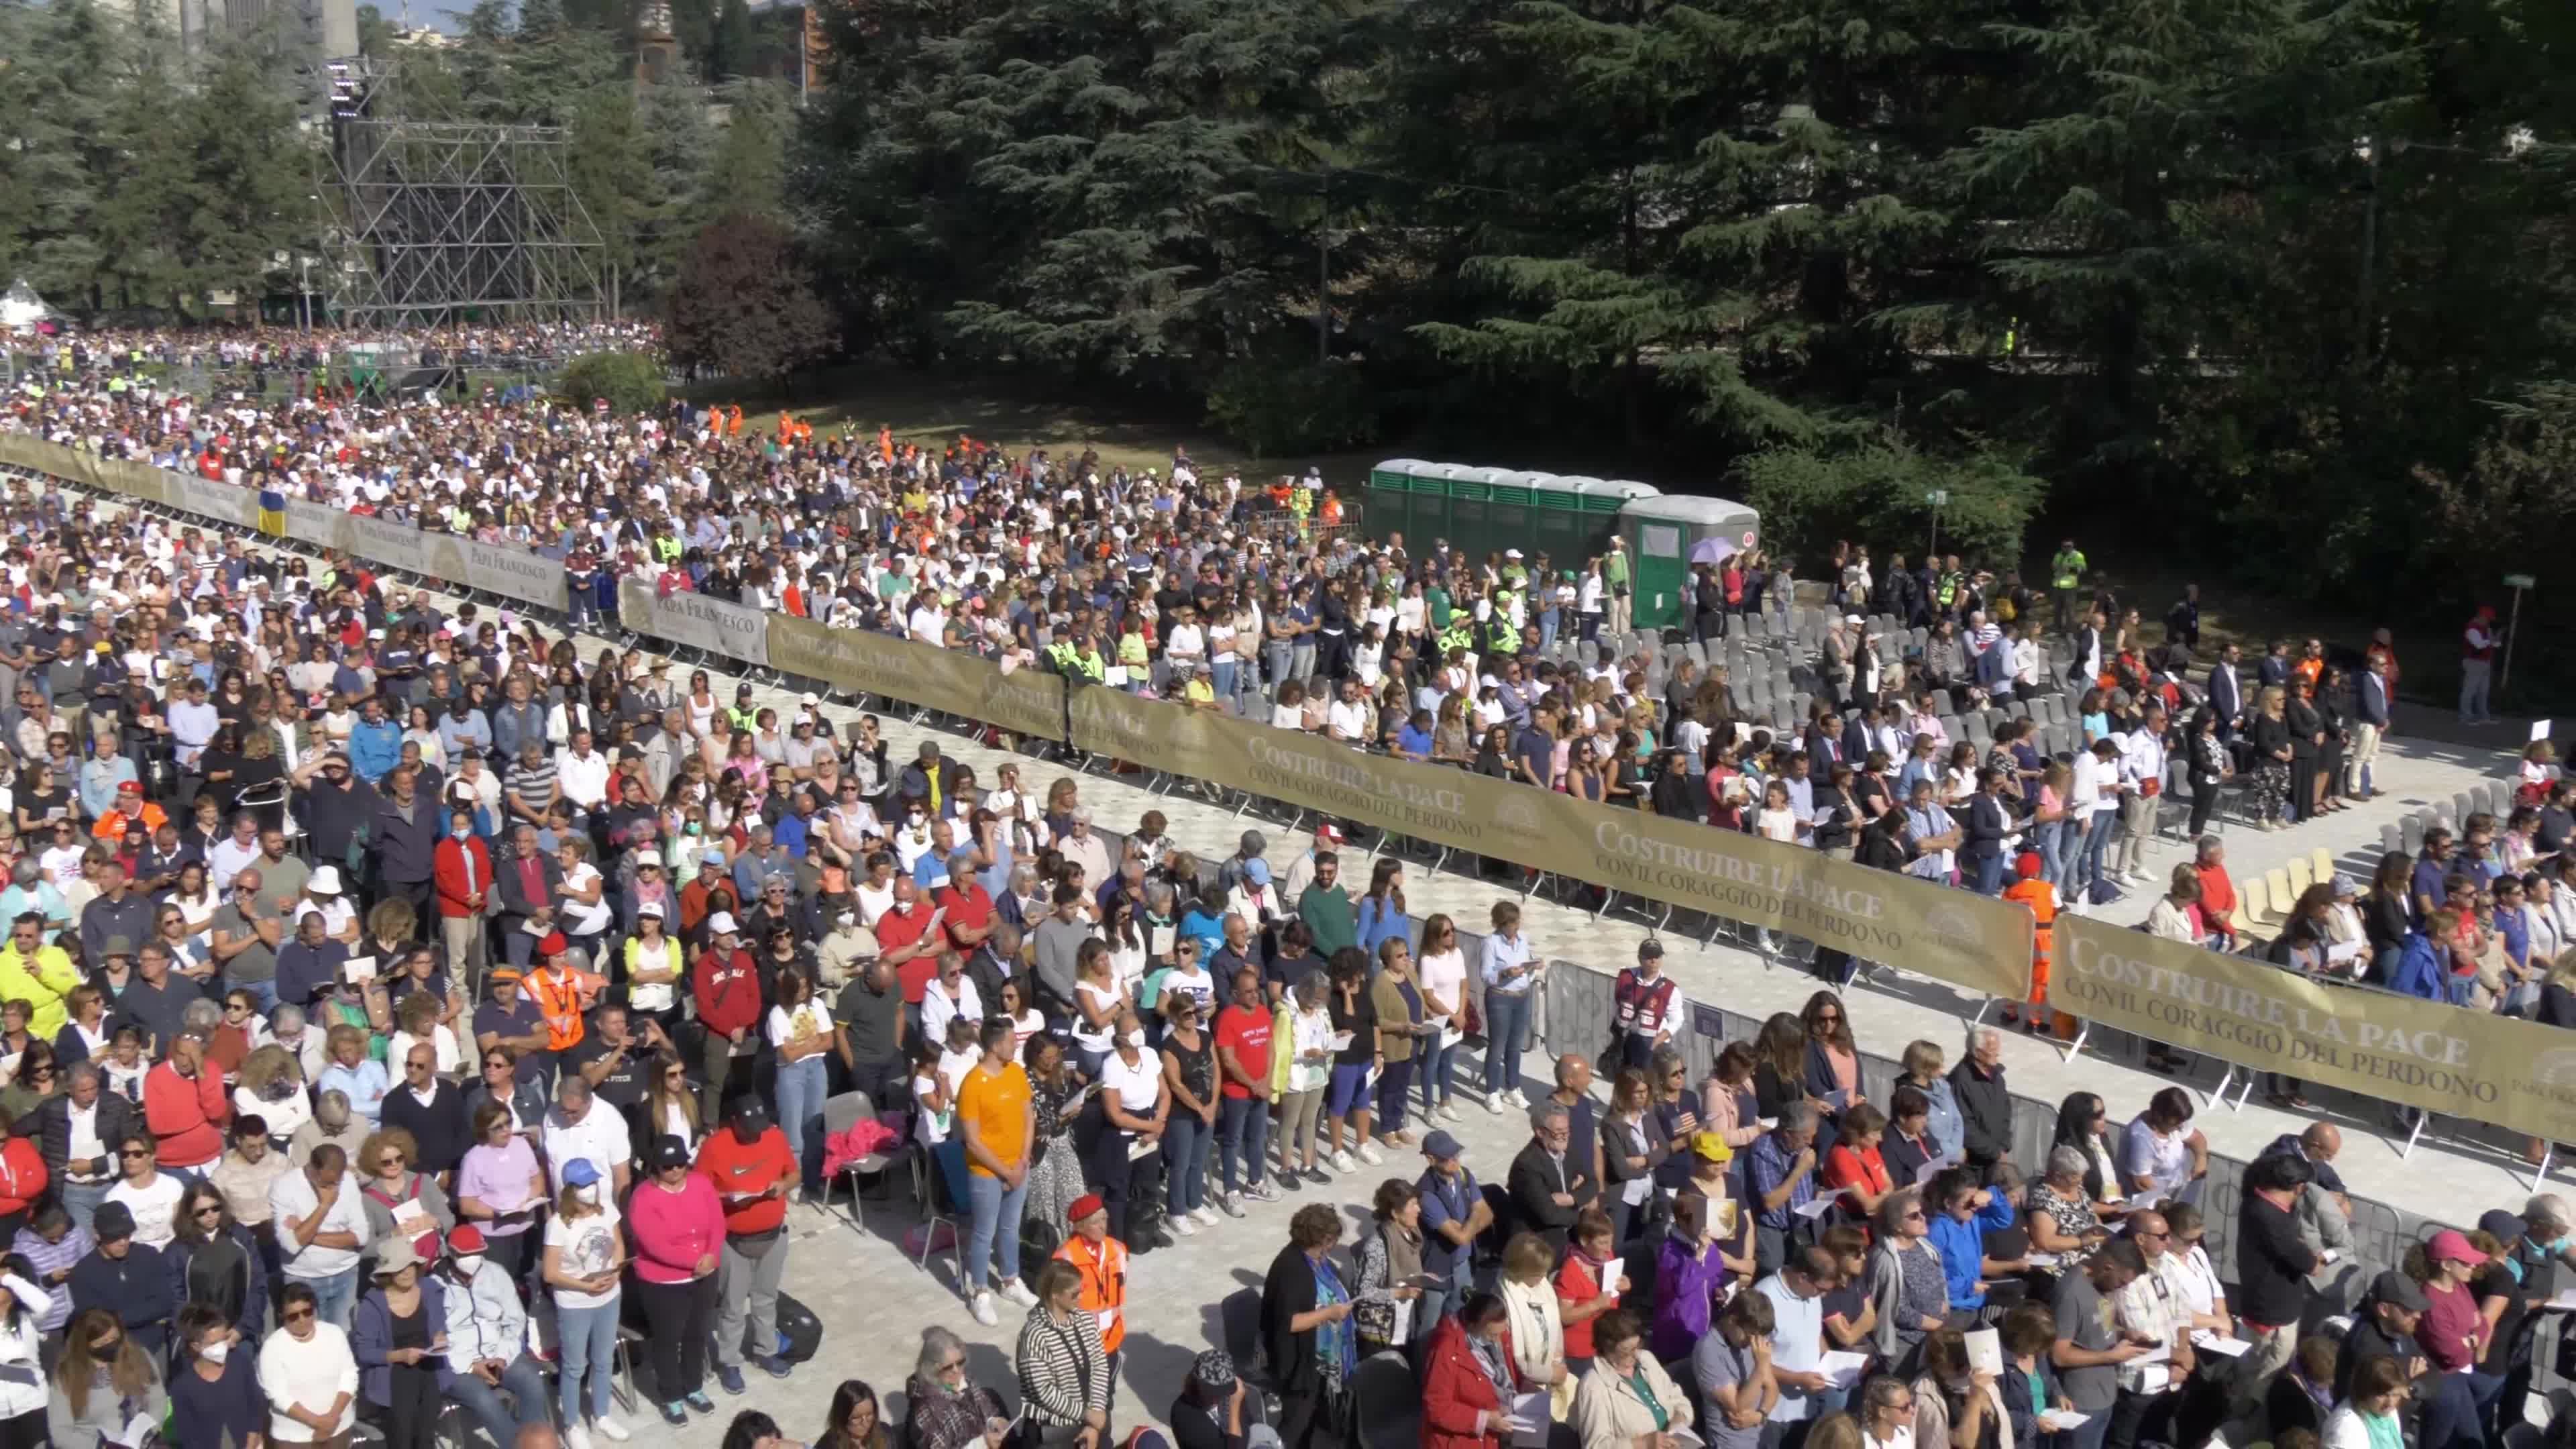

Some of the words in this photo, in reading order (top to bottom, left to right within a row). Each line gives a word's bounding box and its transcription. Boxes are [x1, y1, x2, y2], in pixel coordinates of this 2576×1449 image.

[656, 598, 685, 615] PAPA
[1248, 735, 1369, 789] COSTRUIRE
[1376, 775, 1402, 798] LA
[1404, 782, 1466, 815] PACE
[1248, 765, 1279, 784] CON
[1295, 779, 1371, 810] CORAGGIO
[1374, 799, 1401, 819] DEL
[1403, 806, 1482, 839] PERDONO
[1595, 855, 1635, 881] CON
[1636, 863, 1654, 884] IL
[1656, 870, 1762, 908] CORAGGIO
[1765, 894, 1805, 920] DEL
[1806, 906, 1902, 951] PERDONO
[1596, 820, 1764, 886] COSTRUIRE
[1770, 863, 1809, 897] LA
[1811, 876, 1884, 919] PACE
[2065, 975, 2118, 1008] CON
[2120, 991, 2143, 1015] IL
[2147, 999, 2283, 1054] CORAGGIO
[2288, 1038, 2345, 1070] DEL
[2349, 1051, 2498, 1104] PERDONO
[2068, 936, 2288, 1026] COSTRUIRE
[2296, 1008, 2349, 1045] LA
[2357, 1022, 2470, 1068] PACE
